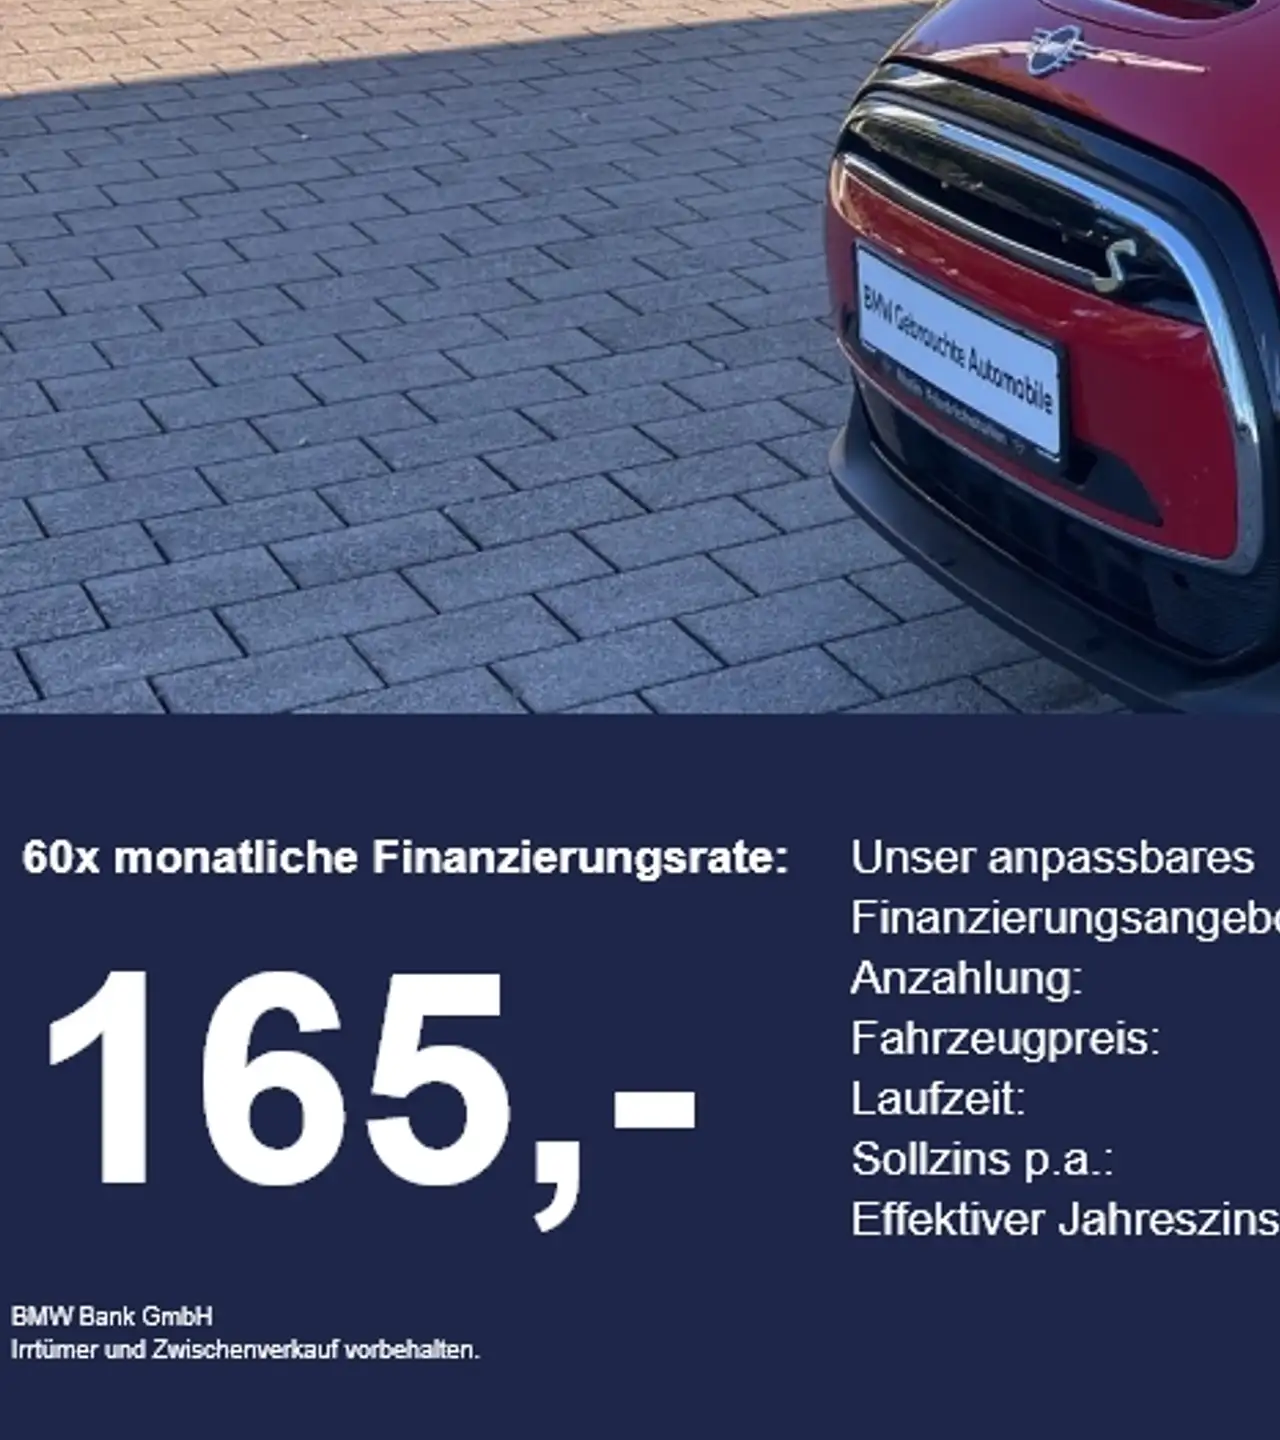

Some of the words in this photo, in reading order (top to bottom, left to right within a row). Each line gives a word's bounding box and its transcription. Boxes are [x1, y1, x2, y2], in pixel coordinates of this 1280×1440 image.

[863, 285, 893, 326] BMW
[894, 304, 966, 368] Gebrauchte
[967, 348, 1053, 415] Automobile
